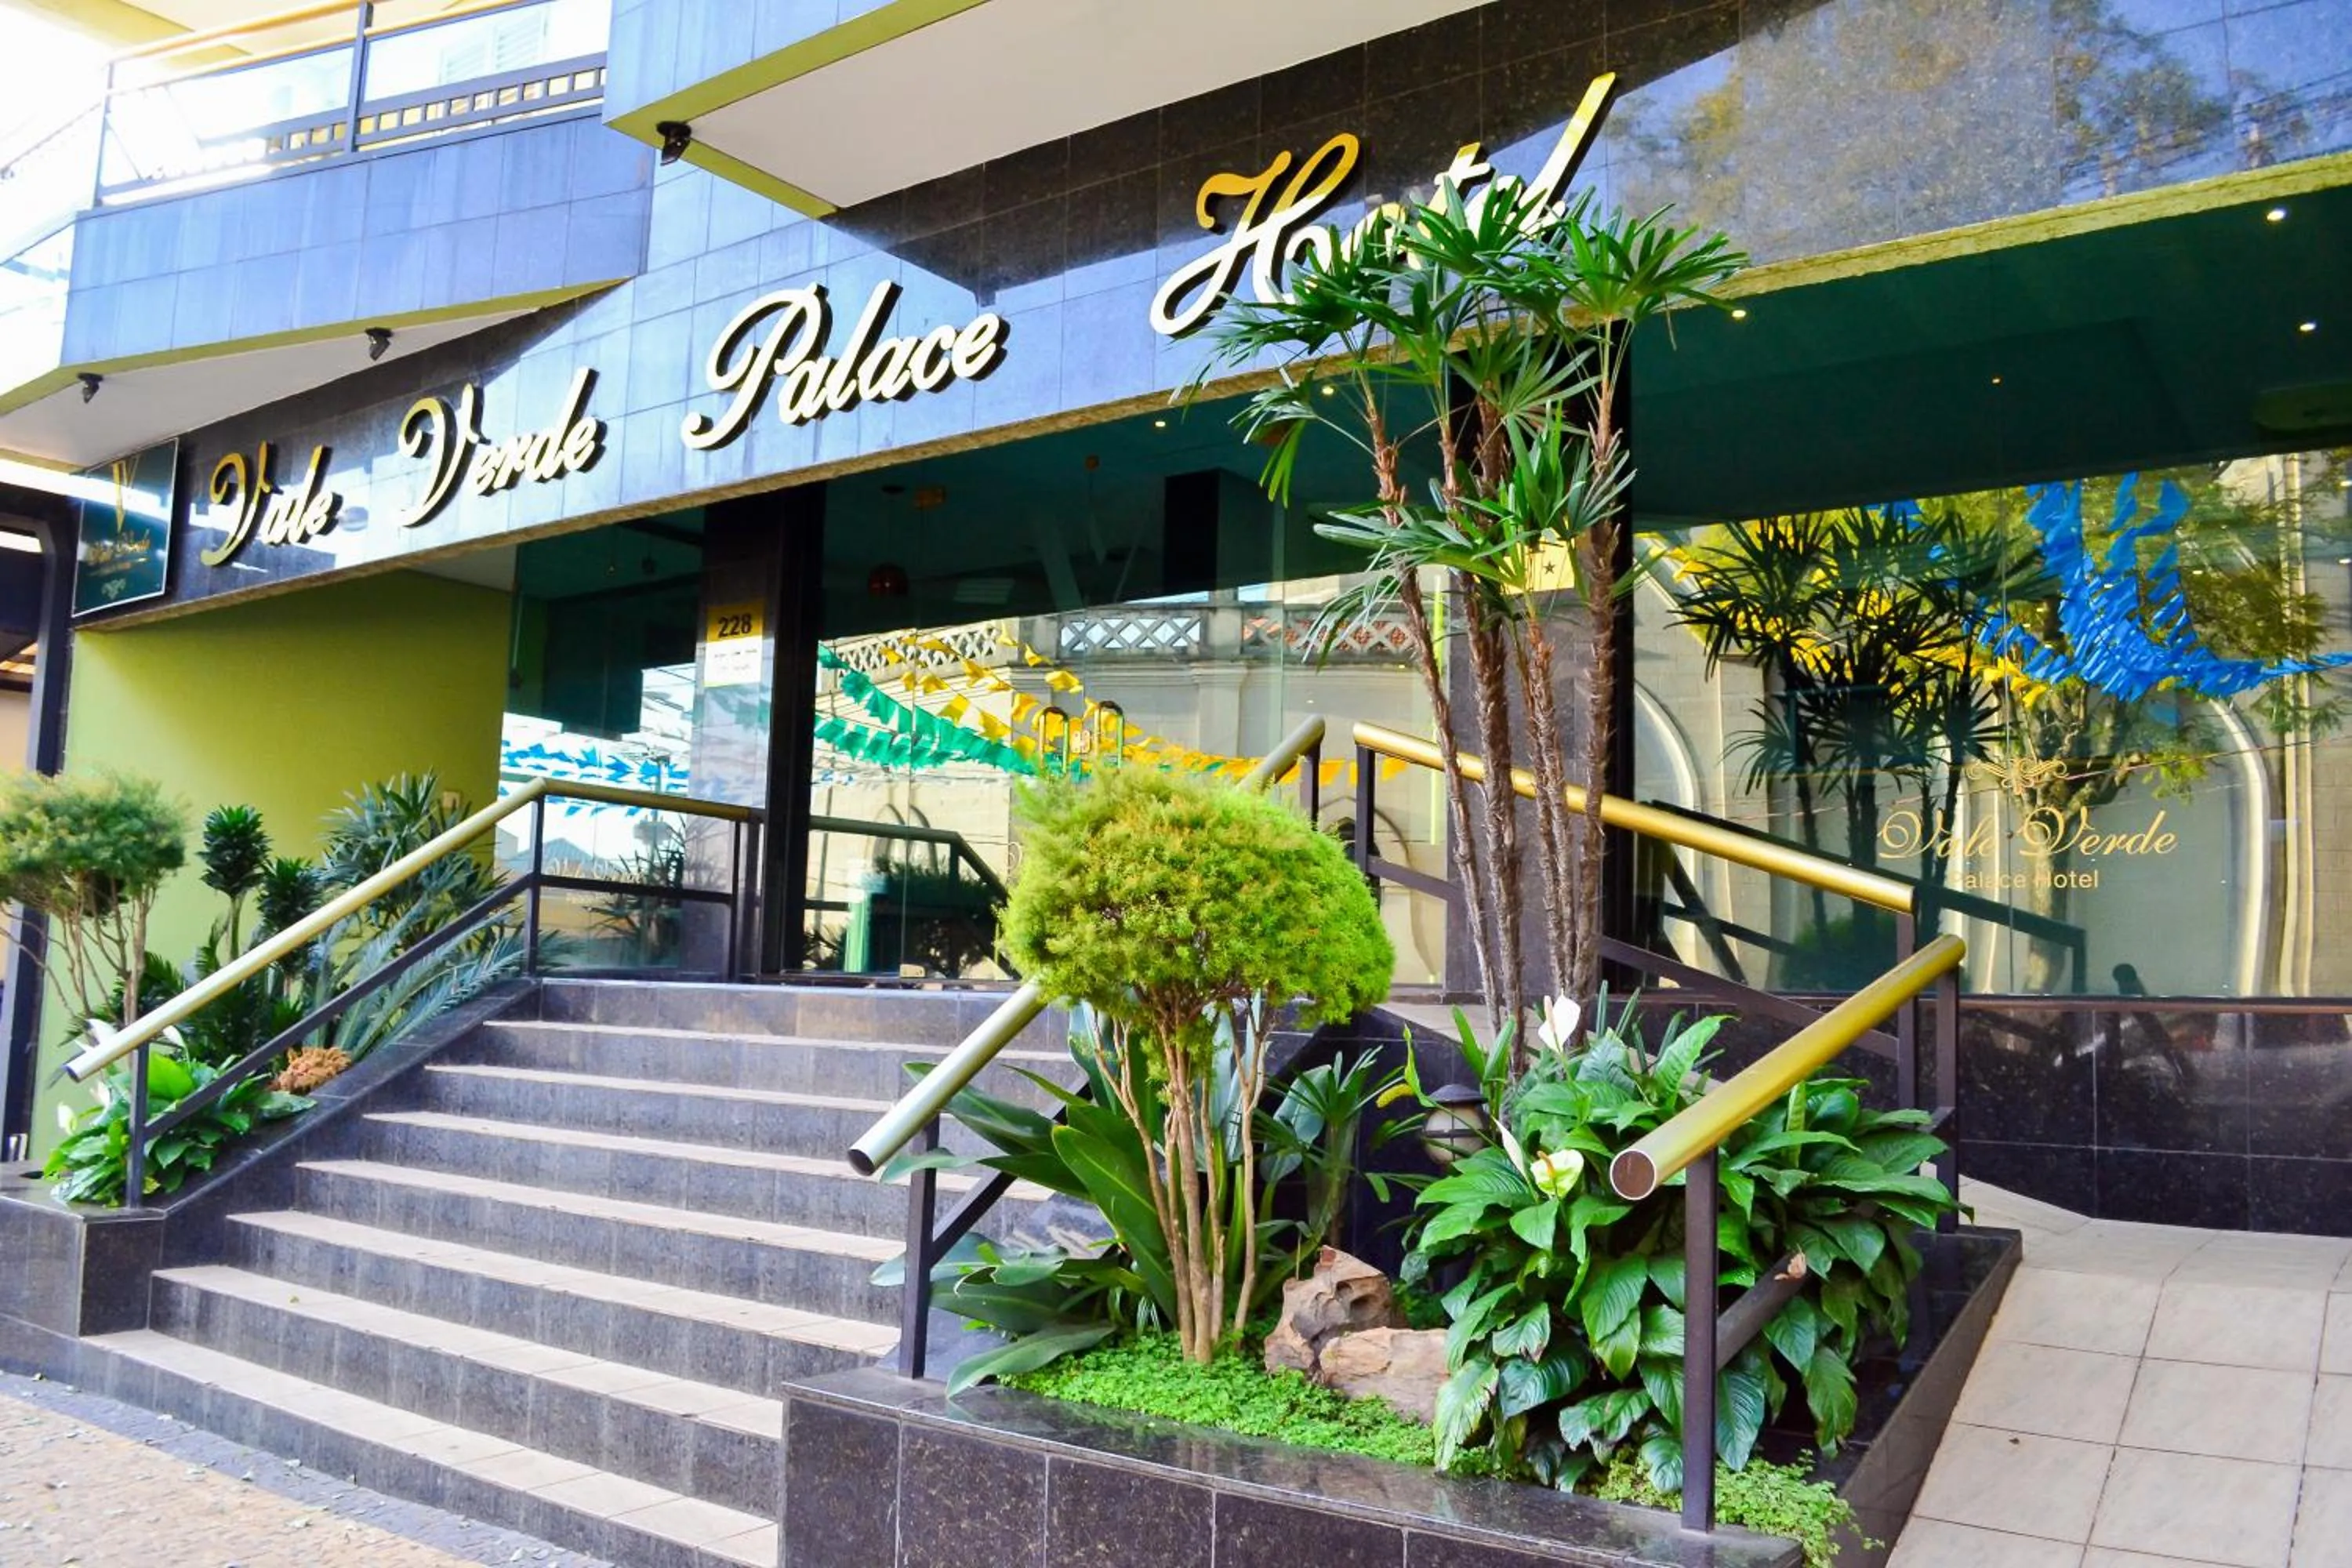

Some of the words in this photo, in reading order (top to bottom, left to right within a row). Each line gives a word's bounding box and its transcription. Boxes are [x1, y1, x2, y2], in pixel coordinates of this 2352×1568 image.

[202, 439, 337, 566] Vale
[399, 366, 601, 528] Verde
[681, 278, 1004, 450] Palace
[717, 613, 752, 637] 228
[1877, 808, 1995, 858] Vale
[2016, 805, 2178, 855] Verde
[2034, 869, 2099, 889] Hotel
